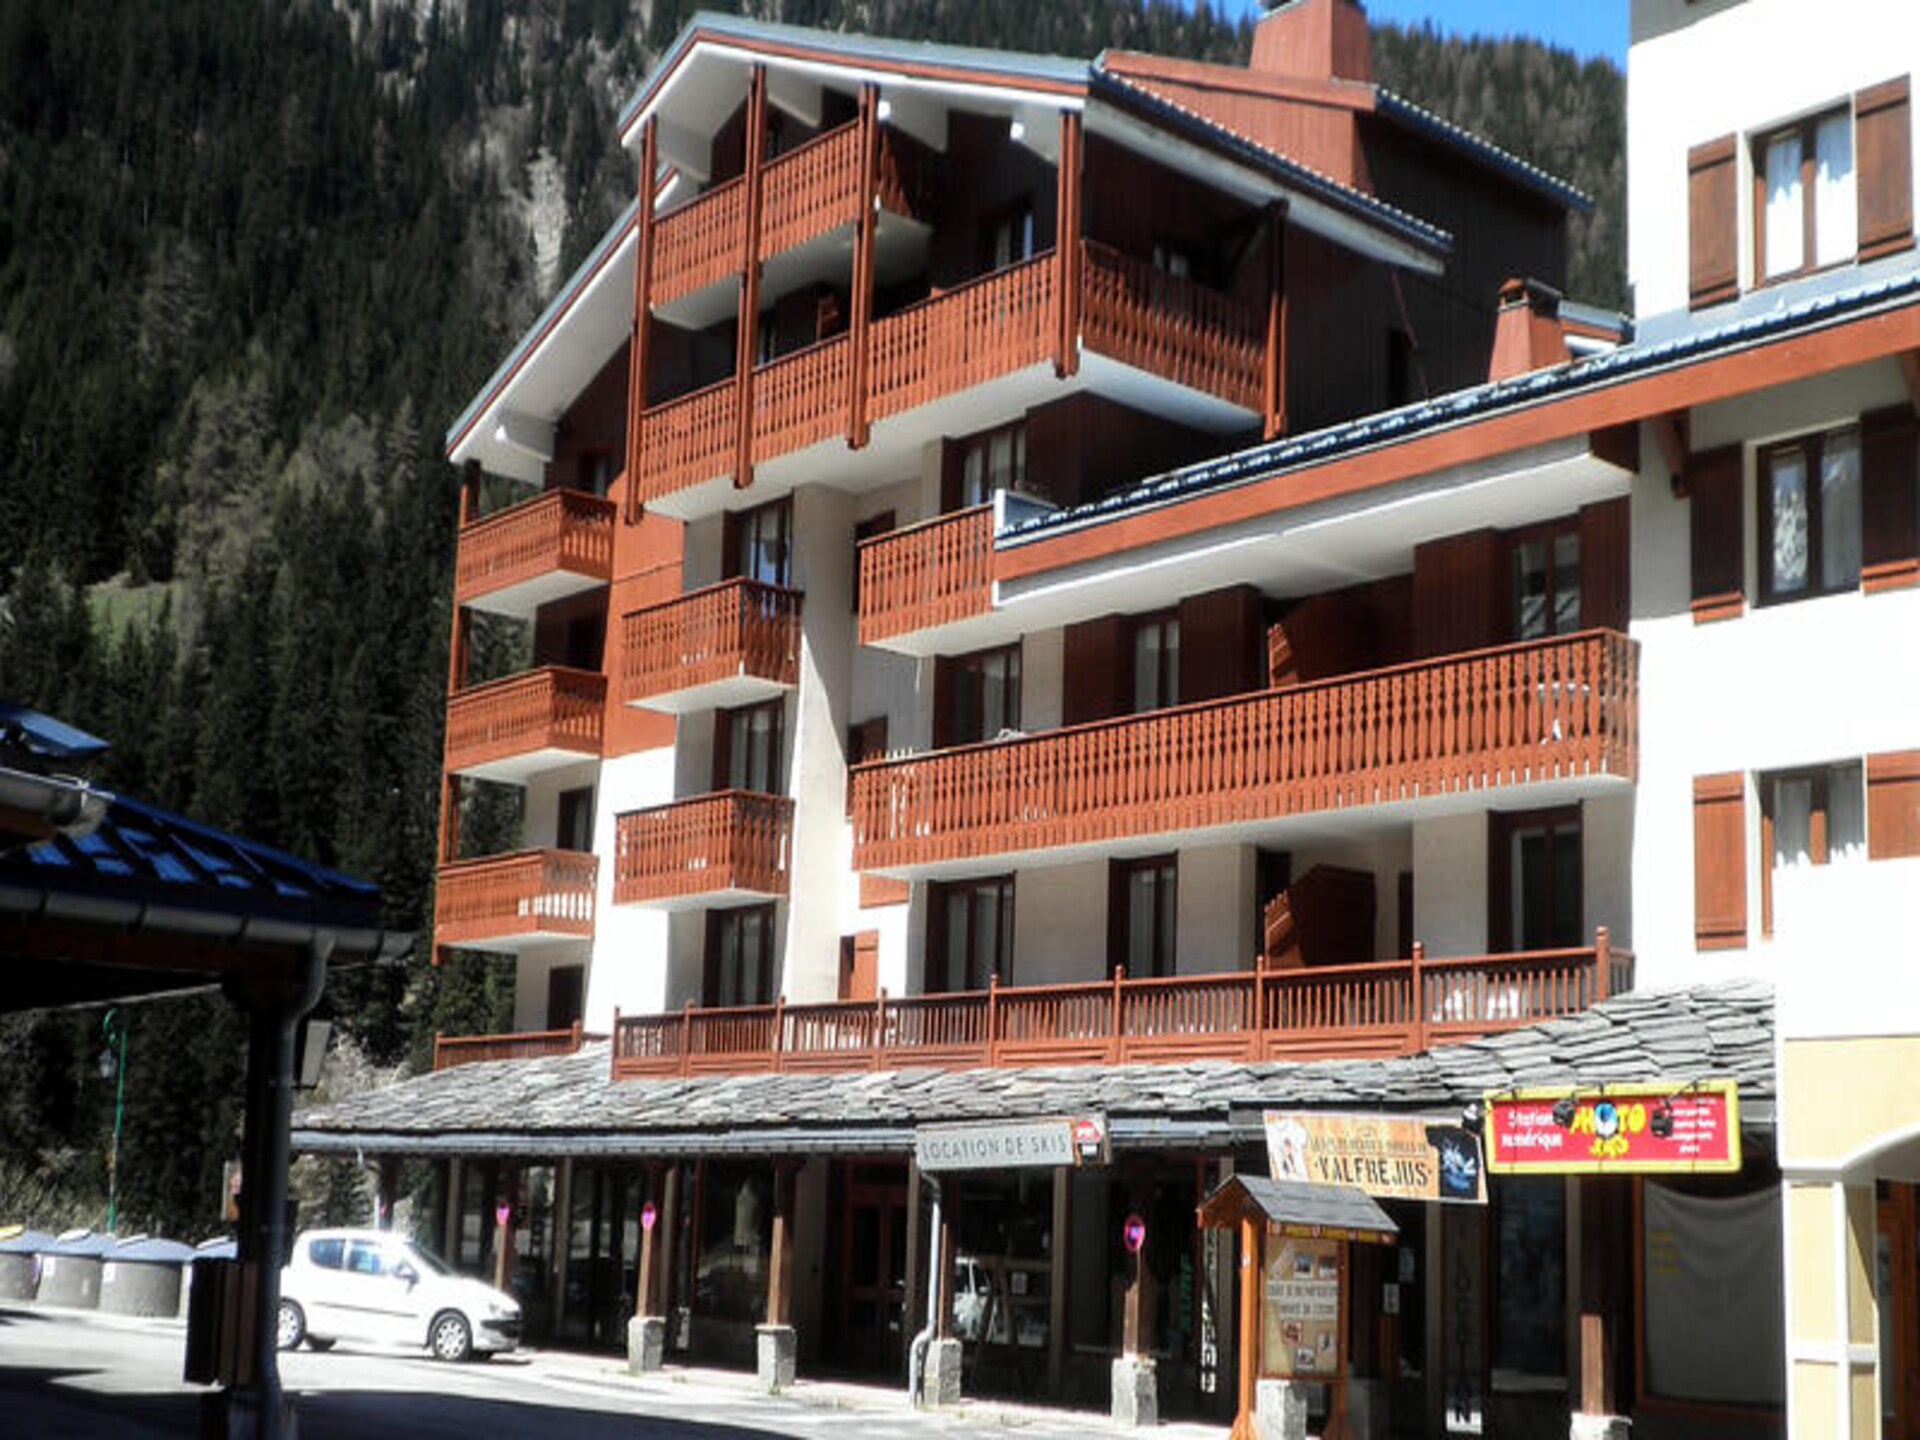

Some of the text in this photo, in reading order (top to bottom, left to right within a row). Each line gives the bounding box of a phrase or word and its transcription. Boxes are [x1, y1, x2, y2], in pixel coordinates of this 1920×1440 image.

[922, 1134, 1067, 1161] LOCATION DE SKIS
